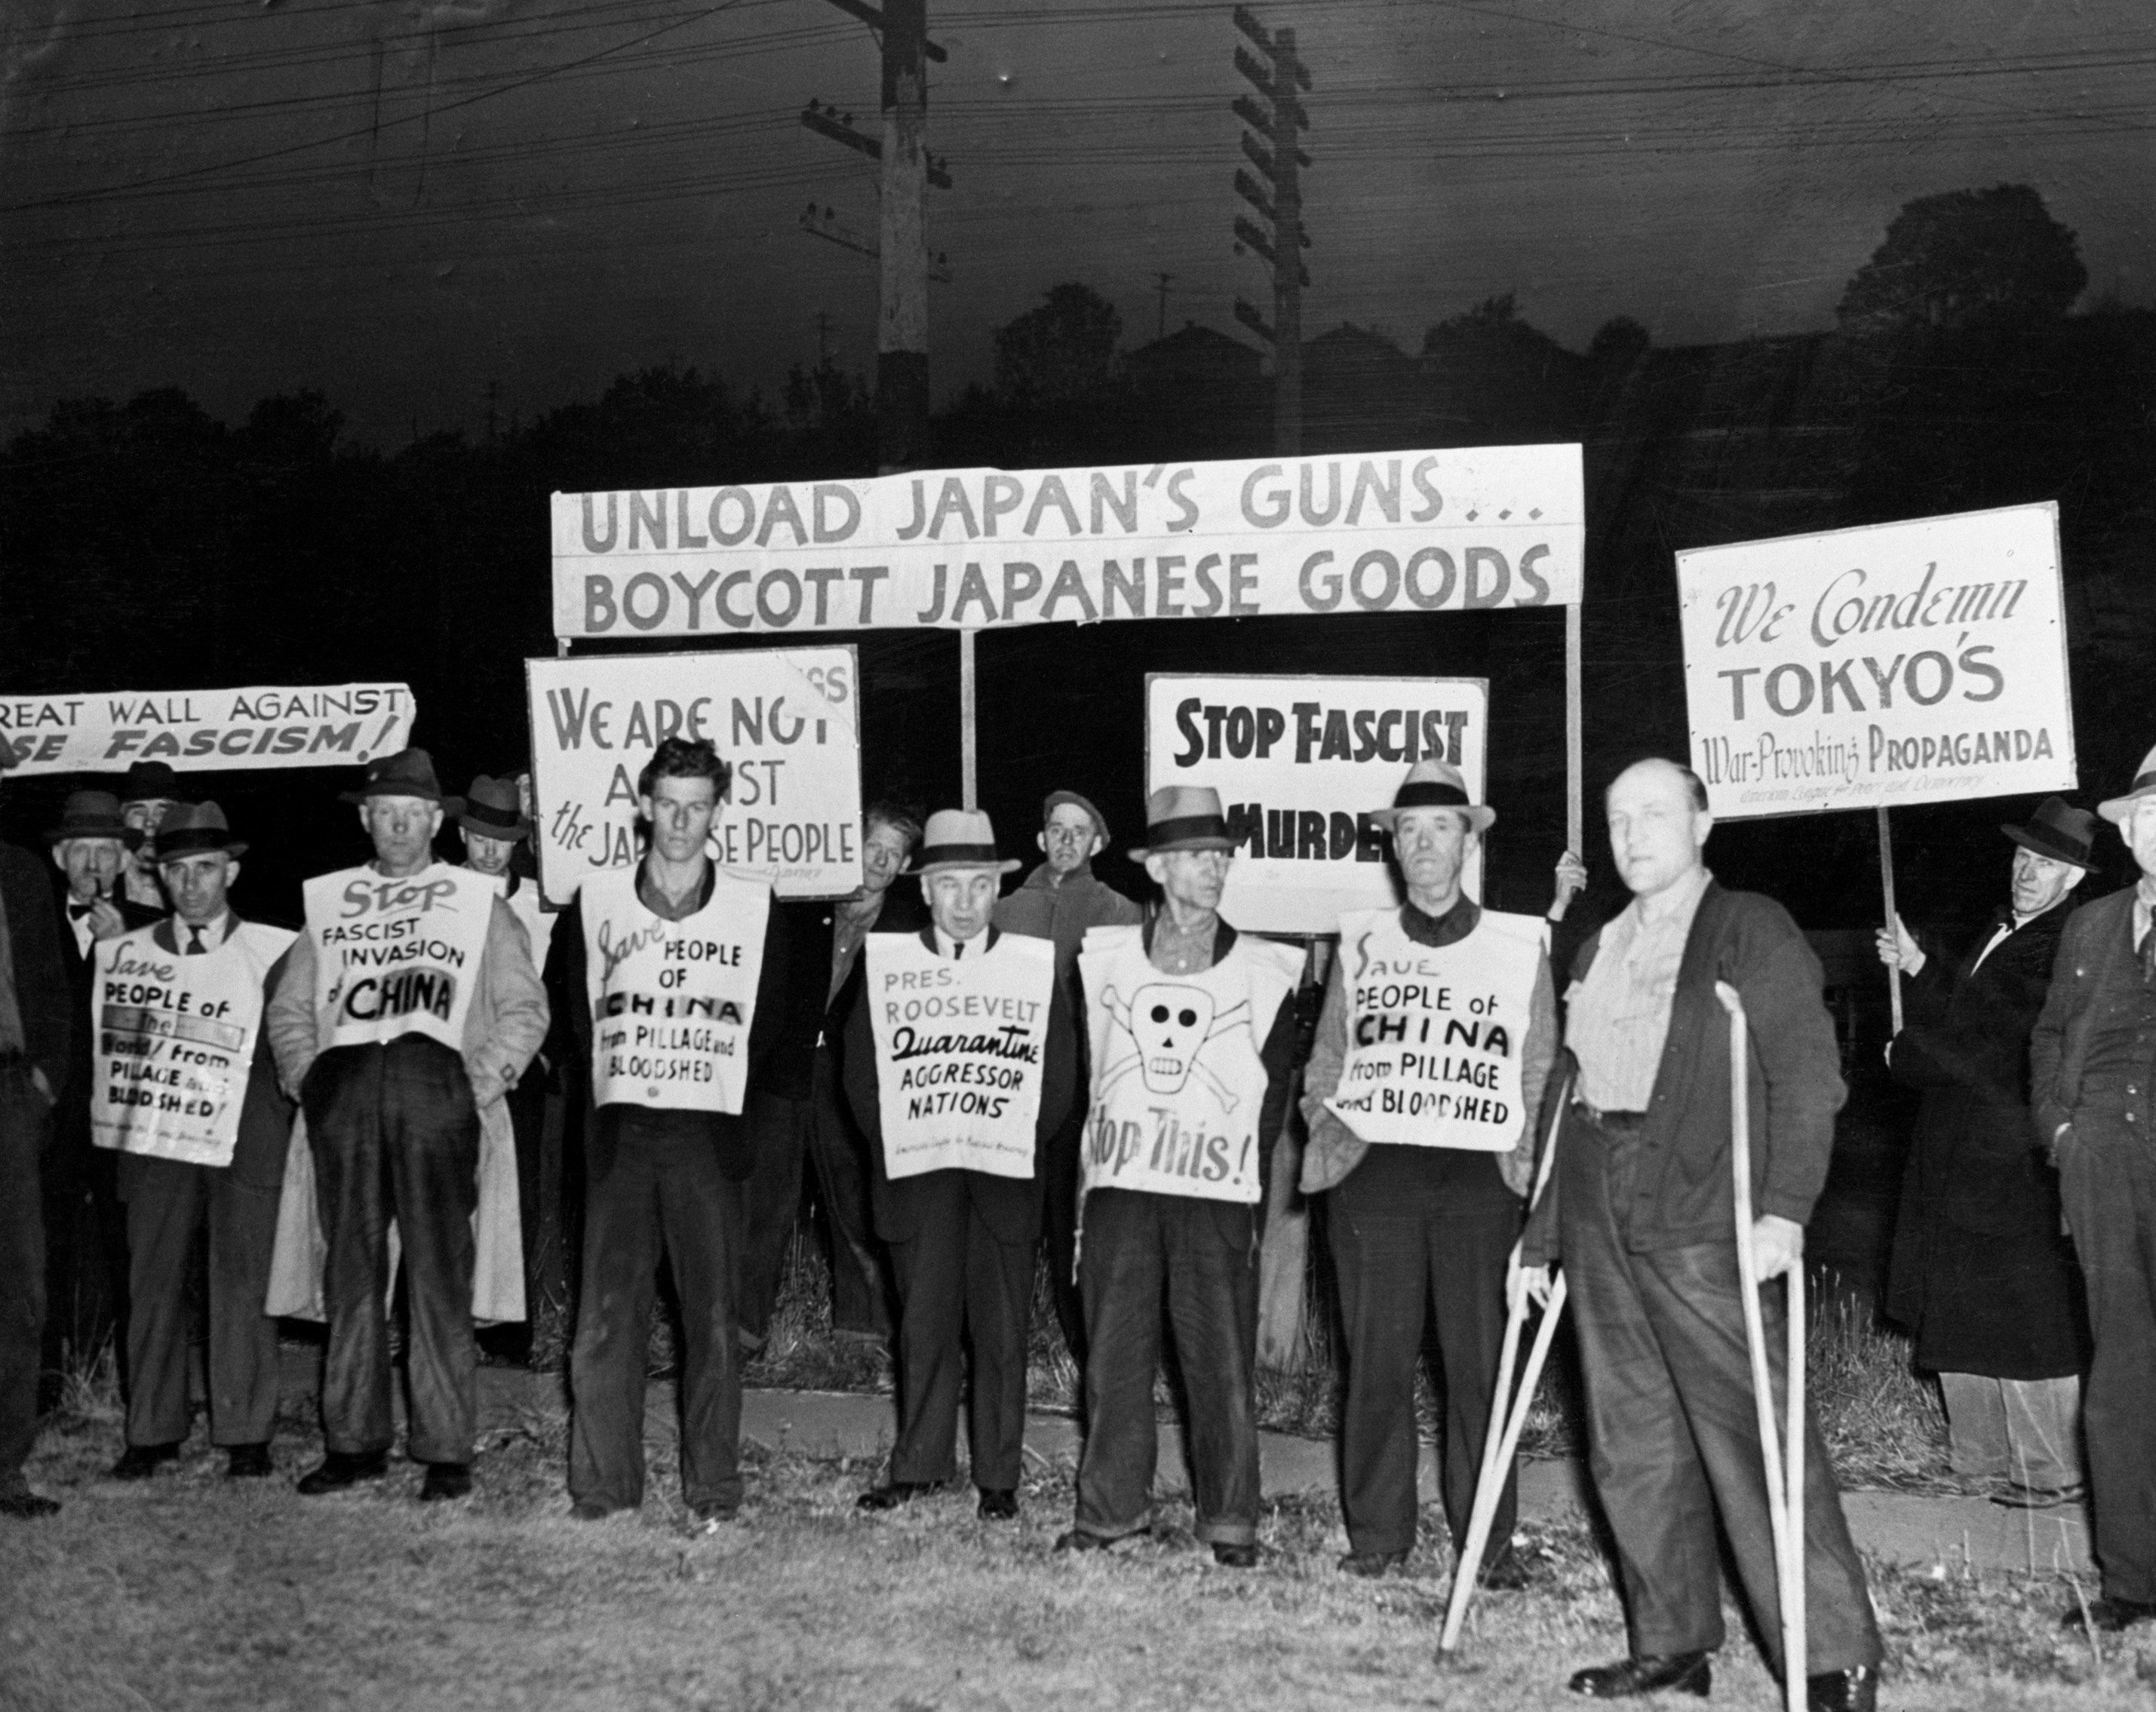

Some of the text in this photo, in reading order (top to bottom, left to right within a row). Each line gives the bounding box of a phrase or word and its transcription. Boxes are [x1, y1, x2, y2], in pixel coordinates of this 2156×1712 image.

[581, 485, 861, 554] UNLOAD
[895, 463, 1199, 542] JAPAN'S
[584, 543, 1551, 634] BOYCOTT JAPANESE GOODS
[1715, 561, 2029, 648] We Condemn
[1717, 631, 2004, 721] TOKYO'S
[109, 698, 201, 725] WALL
[228, 687, 406, 722] AGAINST
[546, 687, 613, 751] WE
[102, 714, 401, 762] FASCISM!
[1174, 697, 1468, 768] STOP FASCIST
[1868, 724, 2054, 772] PROPAGANDA
[551, 801, 593, 851] the
[748, 818, 854, 863] PEOPLE
[1227, 802, 1393, 863] MURDE
[322, 916, 422, 947] FASCIST
[103, 940, 176, 983] Save
[342, 939, 465, 969] INVASION
[664, 940, 742, 967] PEOPLE
[345, 972, 451, 1022] CHINA
[659, 968, 687, 989] OF
[884, 968, 961, 993] PRES.
[104, 983, 231, 1018] PEOPLE of
[606, 992, 744, 1026] CHINA
[886, 996, 1041, 1024] ROOSEVELT
[1356, 984, 1499, 1017] PEOPLE of
[636, 1025, 712, 1053] PILLAGE
[1356, 1014, 1510, 1058] CHINA
[170, 1045, 230, 1069] from
[1400, 1052, 1500, 1091] PILLAGE
[900, 1063, 1024, 1091] AGGRESSOR
[908, 1092, 1009, 1120] NATIONS
